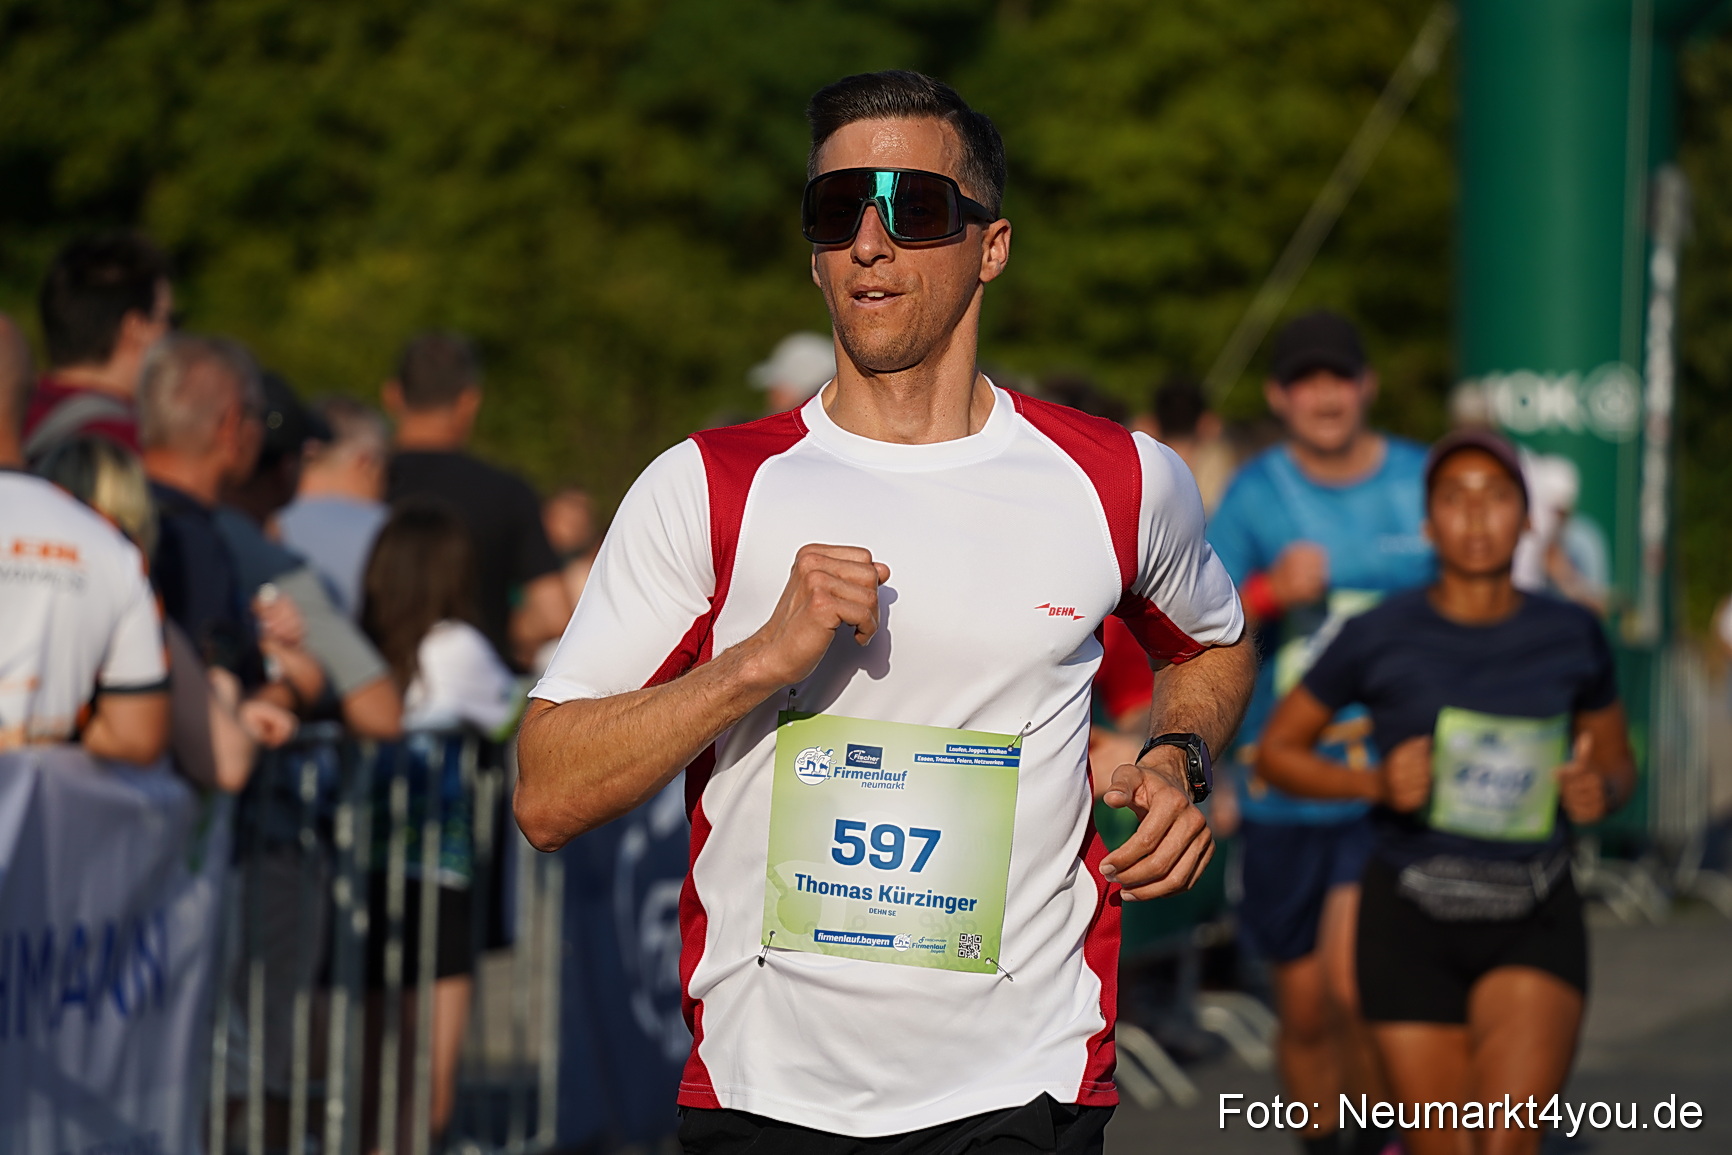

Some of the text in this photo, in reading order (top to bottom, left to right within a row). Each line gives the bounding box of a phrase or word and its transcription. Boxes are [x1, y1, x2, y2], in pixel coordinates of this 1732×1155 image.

[1048, 607, 1075, 616] DEHN
[850, 751, 880, 762] Fischer
[833, 766, 908, 783] Firmenlauf
[861, 780, 905, 790] neumarkt
[831, 818, 942, 873] 597
[795, 873, 978, 914] Thomas Kürzinger
[868, 907, 887, 915] DEHN
[817, 932, 890, 946] firmenlauf.bayern
[911, 942, 946, 950] Firmenlauf
